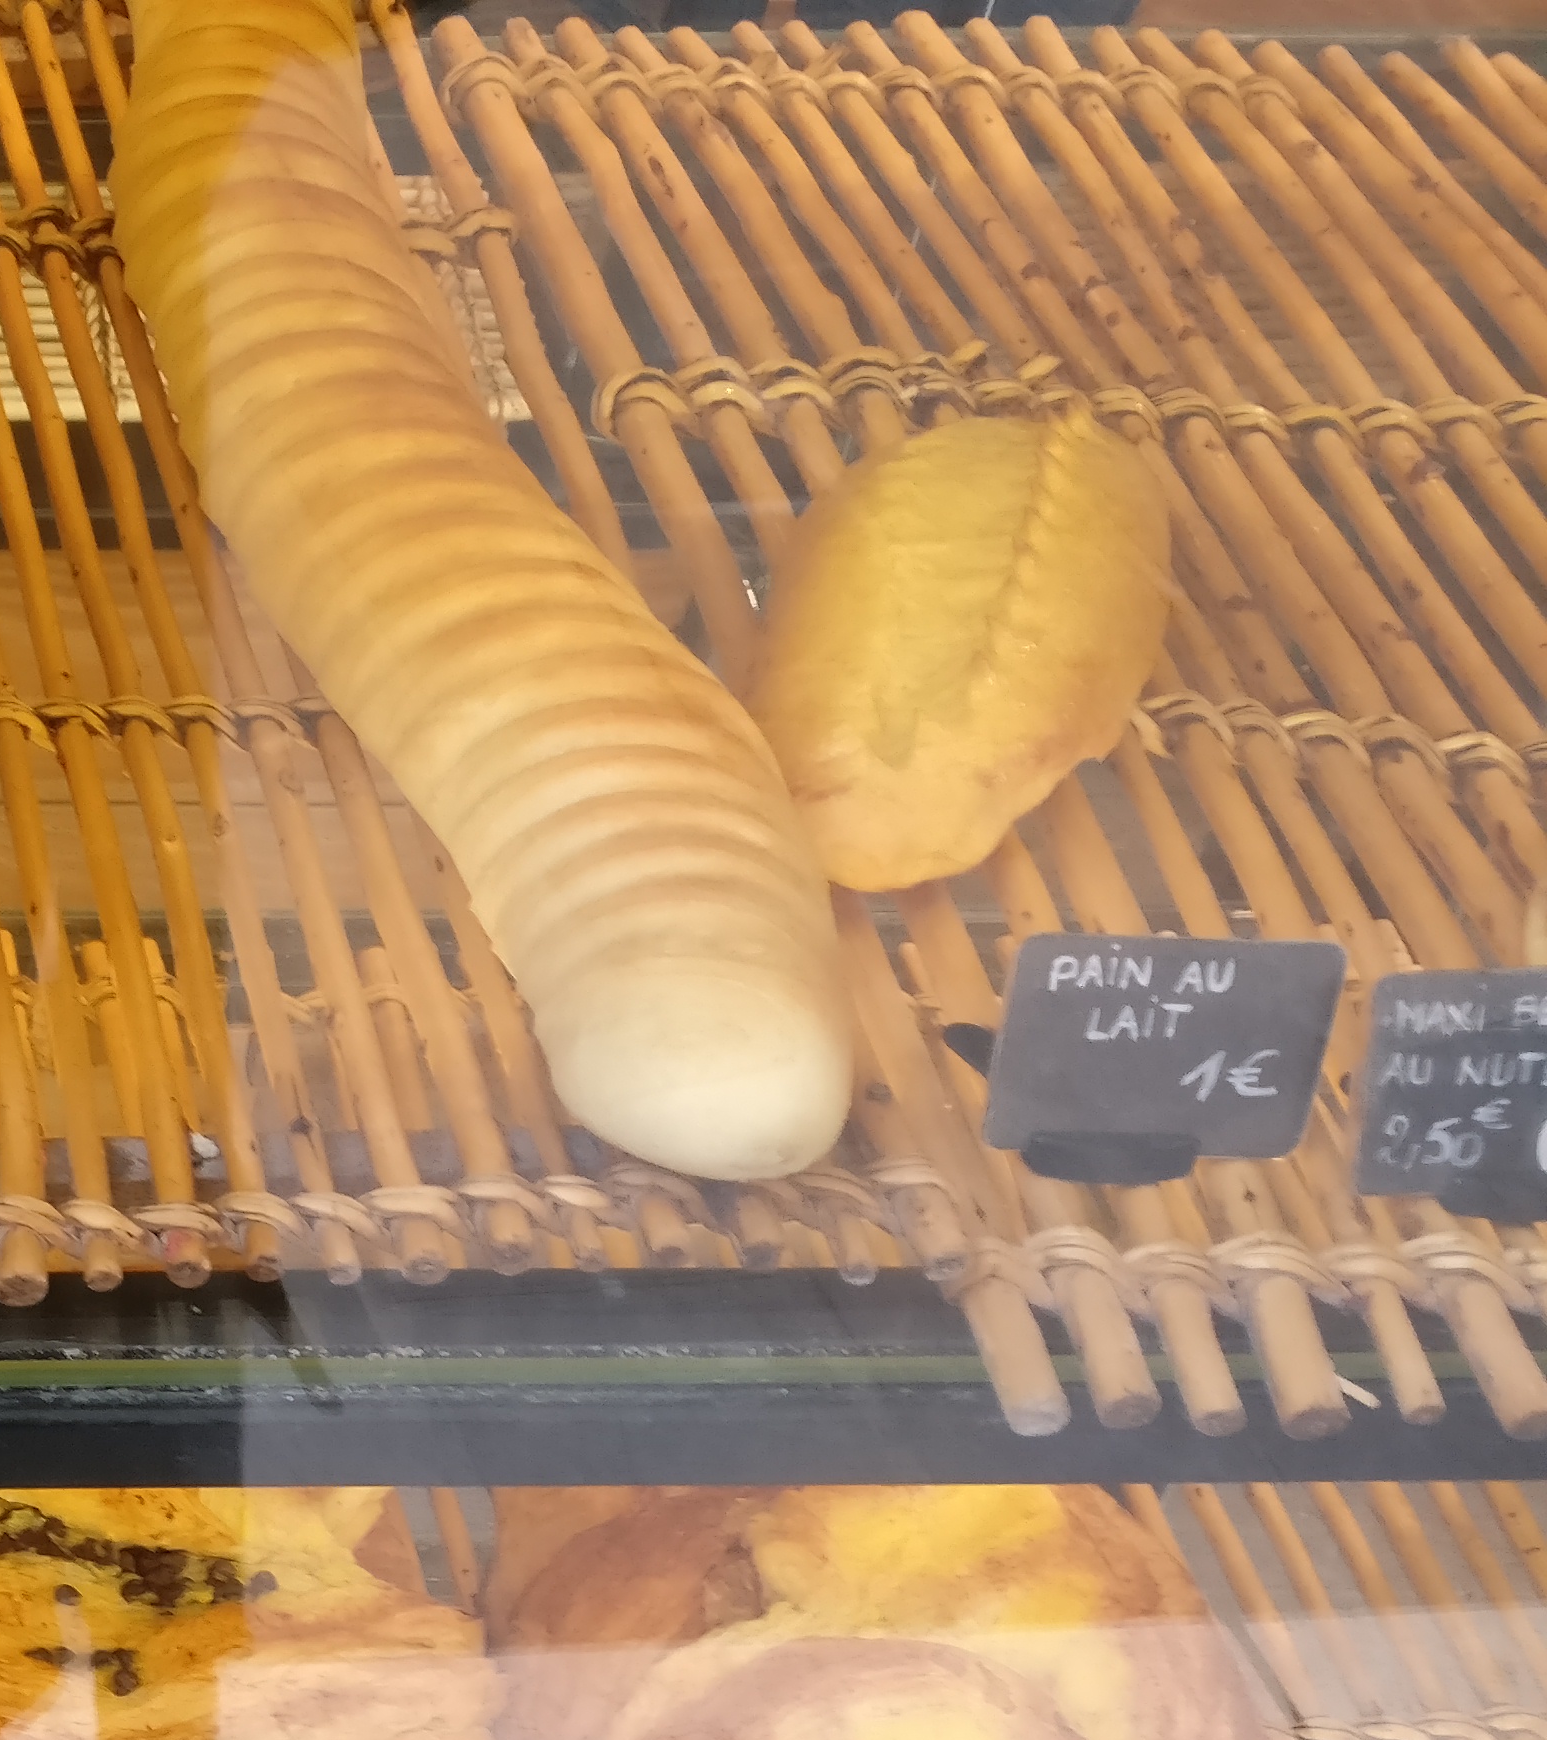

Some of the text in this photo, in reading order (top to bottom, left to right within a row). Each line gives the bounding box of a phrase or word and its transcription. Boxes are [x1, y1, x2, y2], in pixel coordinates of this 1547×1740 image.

[1173, 956, 1237, 995] AU
[1179, 1048, 1281, 1102] 1€
[1378, 1051, 1434, 1086] AU
